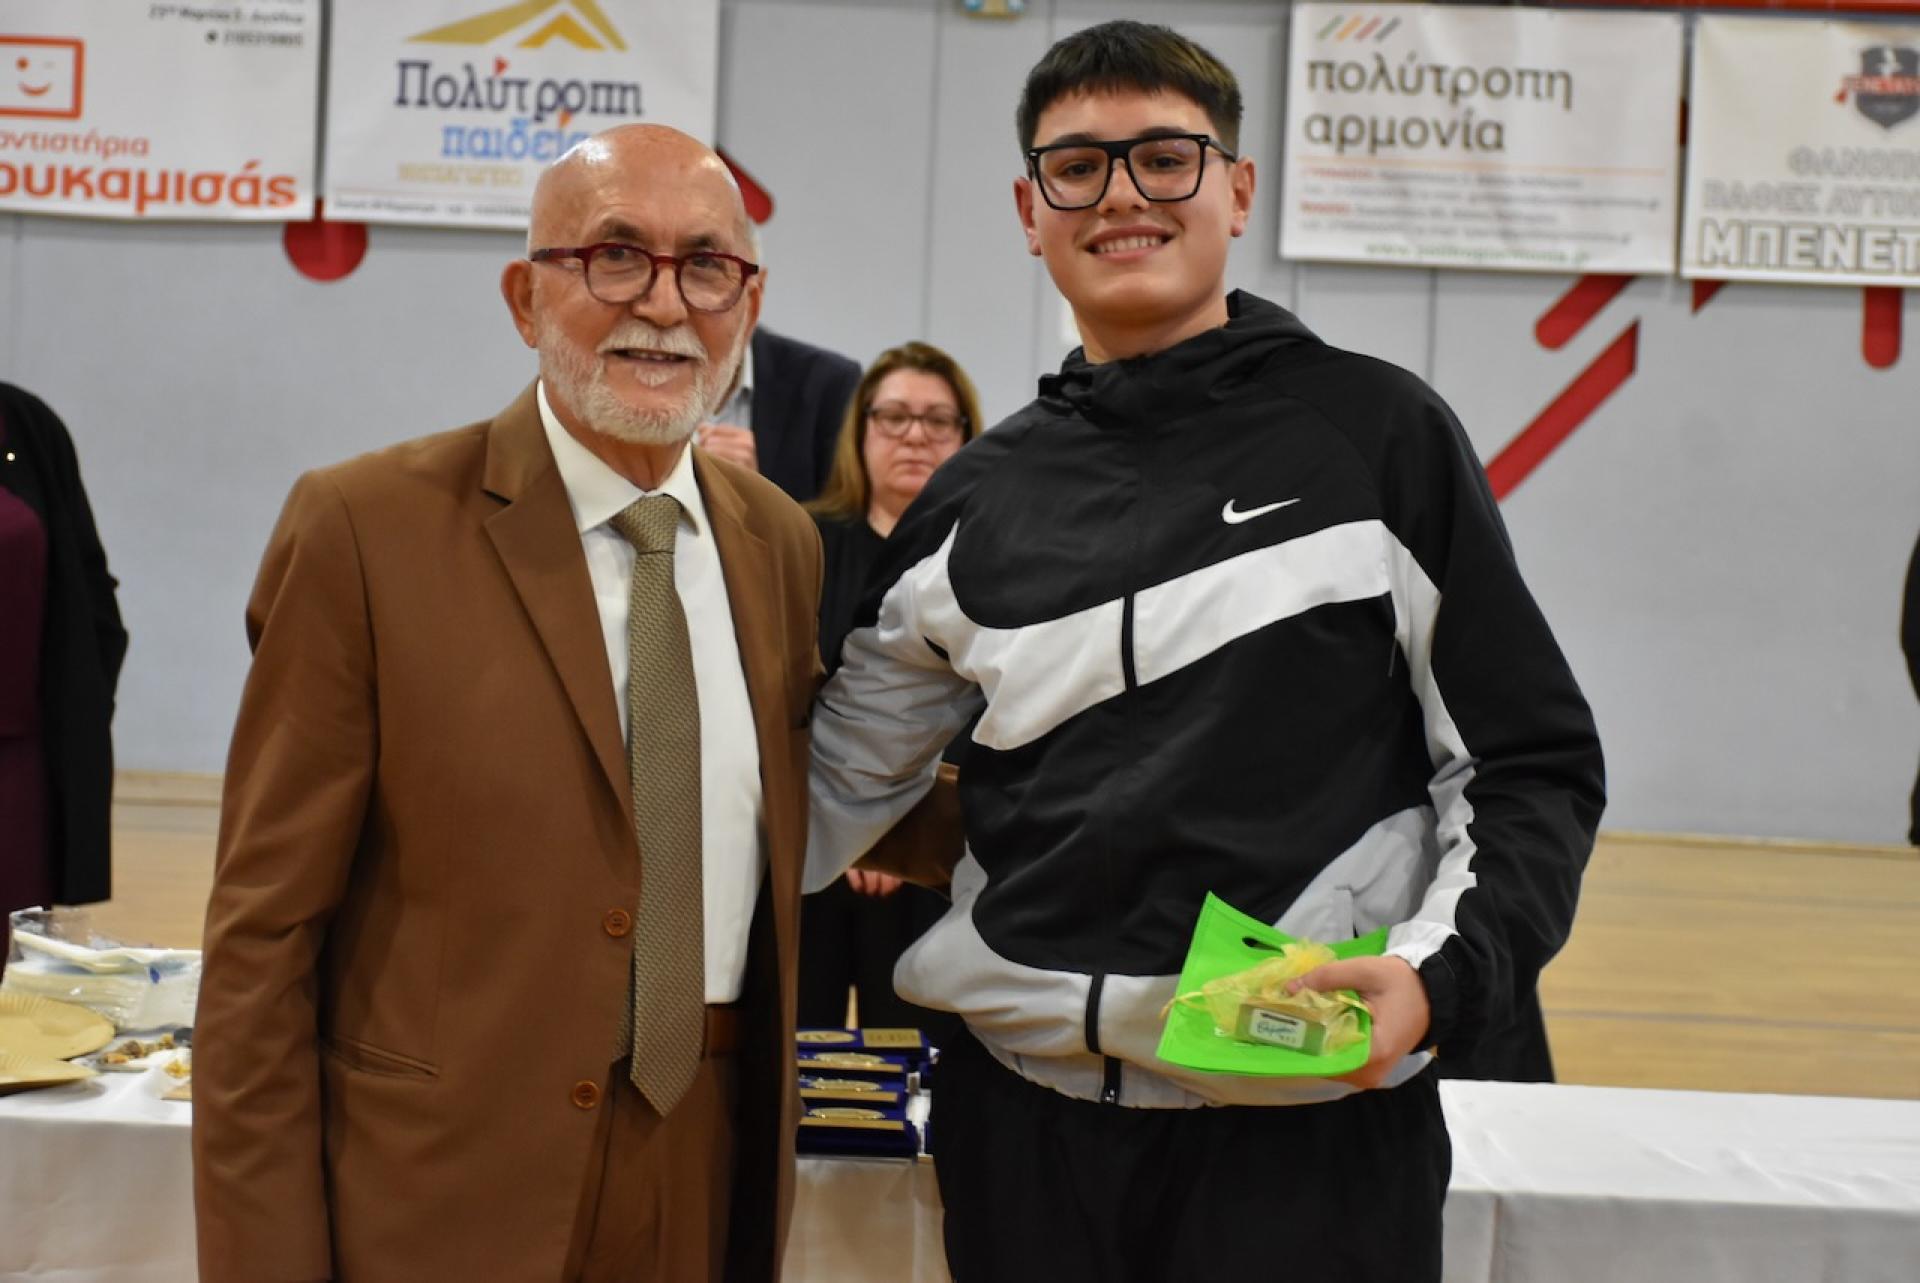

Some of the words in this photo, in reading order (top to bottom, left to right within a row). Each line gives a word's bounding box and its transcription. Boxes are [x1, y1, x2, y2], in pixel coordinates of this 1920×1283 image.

[394, 57, 645, 122] Πολύτροπη
[1306, 51, 1574, 111] πολύτροπη
[1304, 108, 1507, 155] αρμονία
